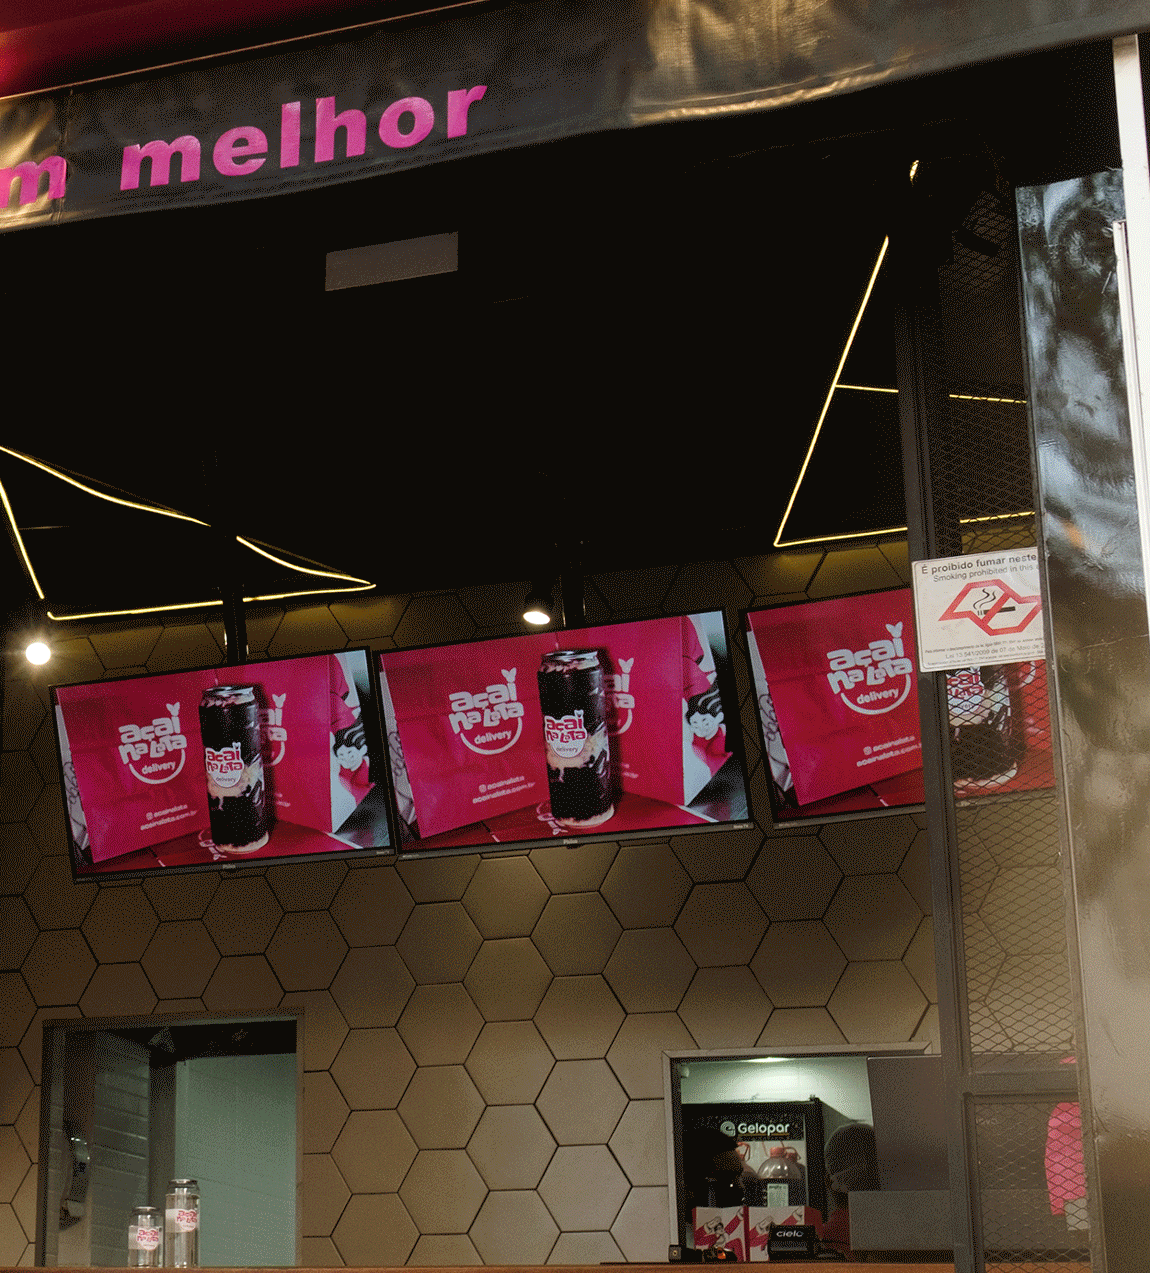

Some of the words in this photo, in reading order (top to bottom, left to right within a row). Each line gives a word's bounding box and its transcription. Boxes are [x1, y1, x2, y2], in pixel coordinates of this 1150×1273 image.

[119, 84, 488, 193] melhor
[921, 564, 928, 575] É
[931, 561, 973, 575] proibido
[975, 557, 1006, 568] fumar
[1008, 554, 1037, 564] neste
[933, 572, 967, 583] Smoking
[969, 567, 1008, 579] prohibited
[1019, 564, 1034, 572] this
[856, 688, 899, 704] delivery
[473, 729, 512, 745] delivery
[141, 761, 176, 775] delivery
[737, 1122, 790, 1137] Gelopar
[776, 1230, 805, 1238] cielo
